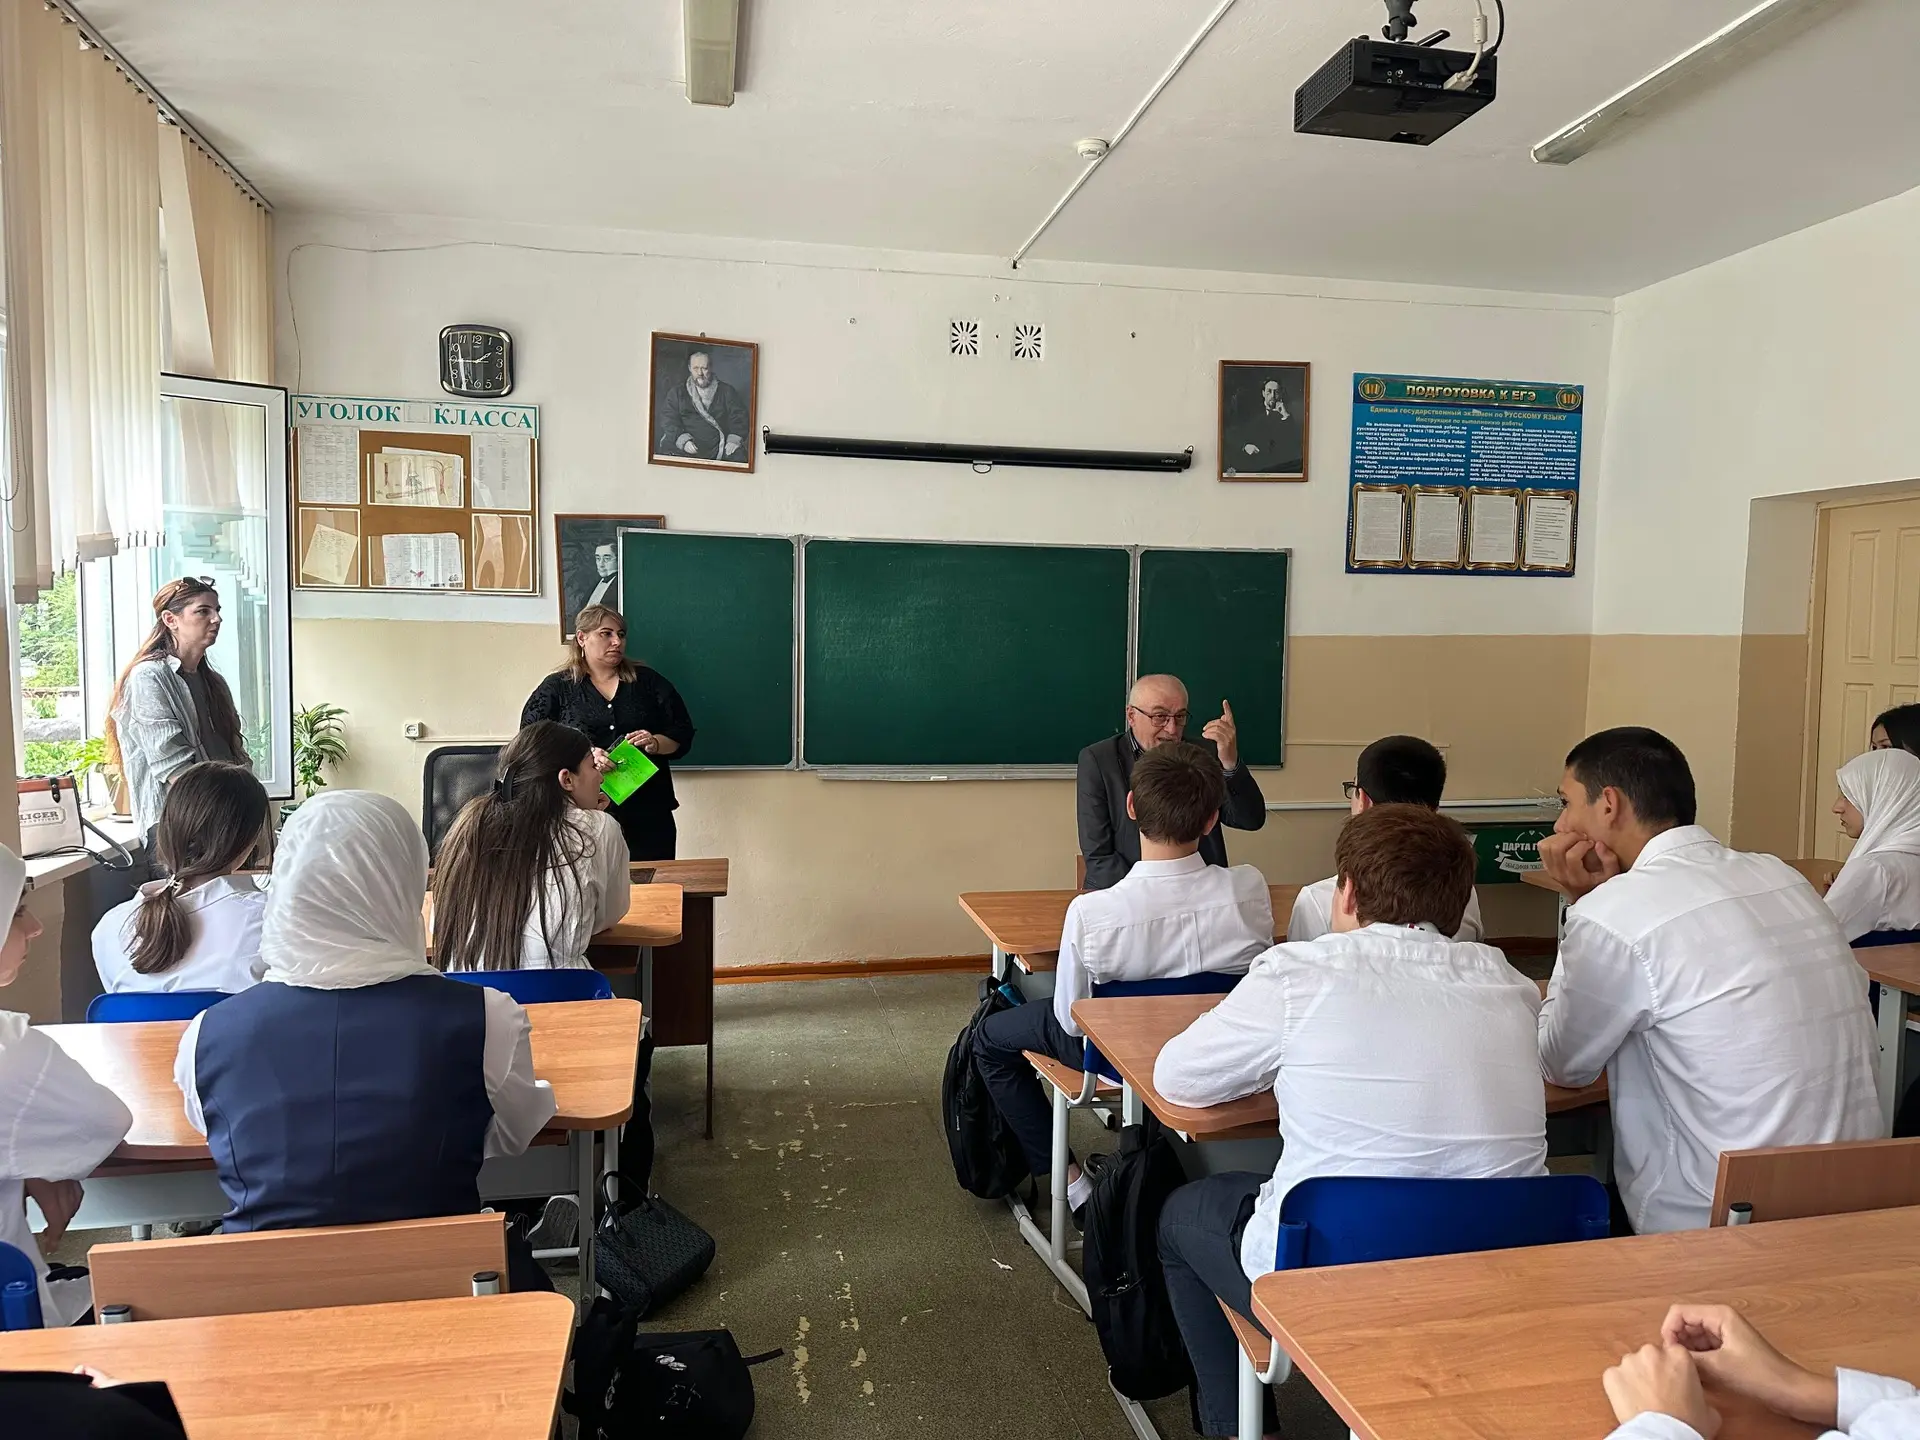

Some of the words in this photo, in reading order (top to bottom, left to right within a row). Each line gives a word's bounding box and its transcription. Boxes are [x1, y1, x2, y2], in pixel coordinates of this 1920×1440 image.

[460, 335, 466, 343] 11
[472, 335, 482, 344] 12
[488, 337, 492, 345] 1
[495, 346, 503, 355] 2
[495, 359, 503, 368] 3
[452, 369, 458, 379] 8
[495, 372, 503, 381] 4
[473, 379, 482, 389] 6
[485, 379, 492, 389] 5
[1406, 384, 1496, 399] ПОДГОТОВКА
[1500, 389, 1508, 400] К
[1511, 390, 1537, 401] ЕГЭ
[299, 402, 401, 422] УГОЛОК
[433, 408, 533, 428] КЛАССА
[1400, 408, 1461, 416] государственный
[1502, 842, 1531, 851] ПАРТА
